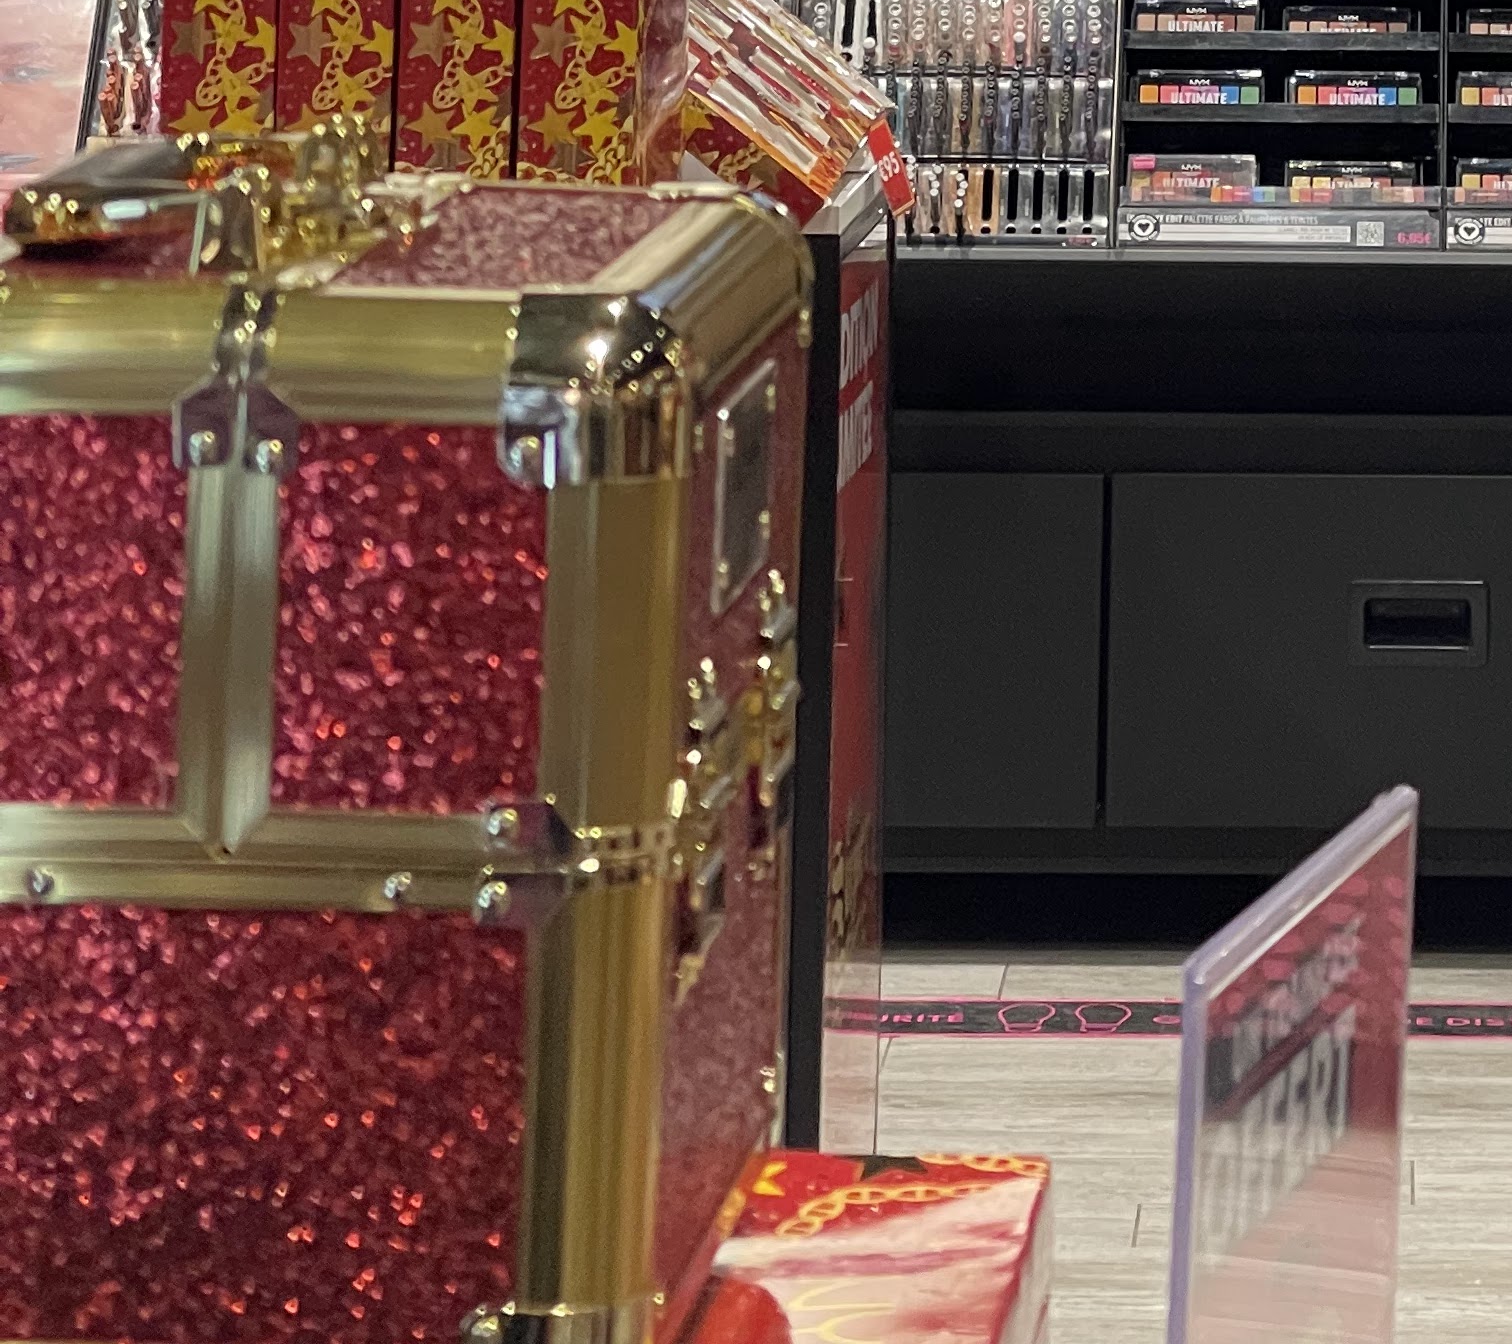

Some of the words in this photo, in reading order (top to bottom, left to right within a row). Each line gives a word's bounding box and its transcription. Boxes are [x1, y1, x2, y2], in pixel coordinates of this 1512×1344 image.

[1168, 21, 1224, 32] ULTIMATE
[1171, 92, 1227, 104] ULTIMATE
[1329, 94, 1385, 105] ULTIMATE
